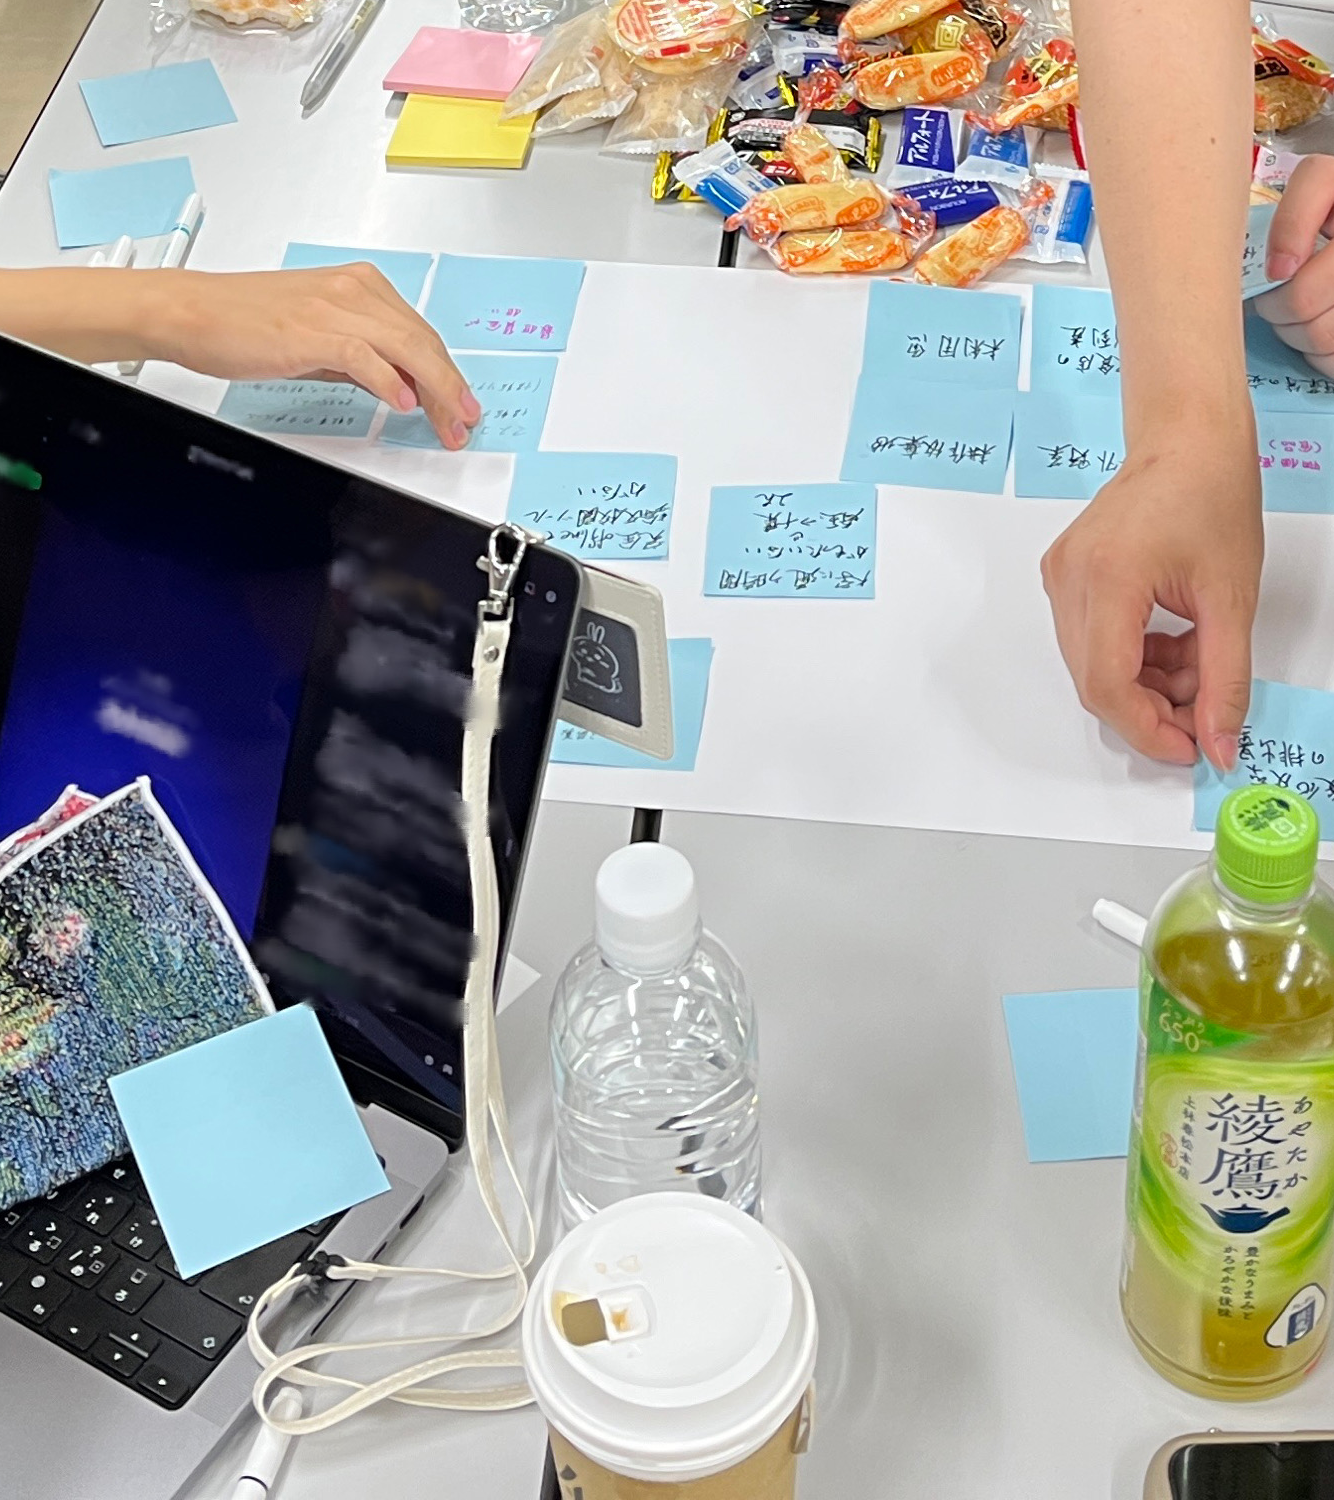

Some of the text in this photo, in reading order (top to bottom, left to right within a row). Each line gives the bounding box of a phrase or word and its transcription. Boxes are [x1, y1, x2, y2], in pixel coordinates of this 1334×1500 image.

[907, 110, 935, 165] アルフォート
[1037, 444, 1125, 473] 外野菜
[1158, 1012, 1200, 1053] 650
[1198, 1091, 1289, 1200] 綾鷹
[1285, 1095, 1314, 1191] あやたか
[1239, 1245, 1261, 1321] 豊かなうまみと
